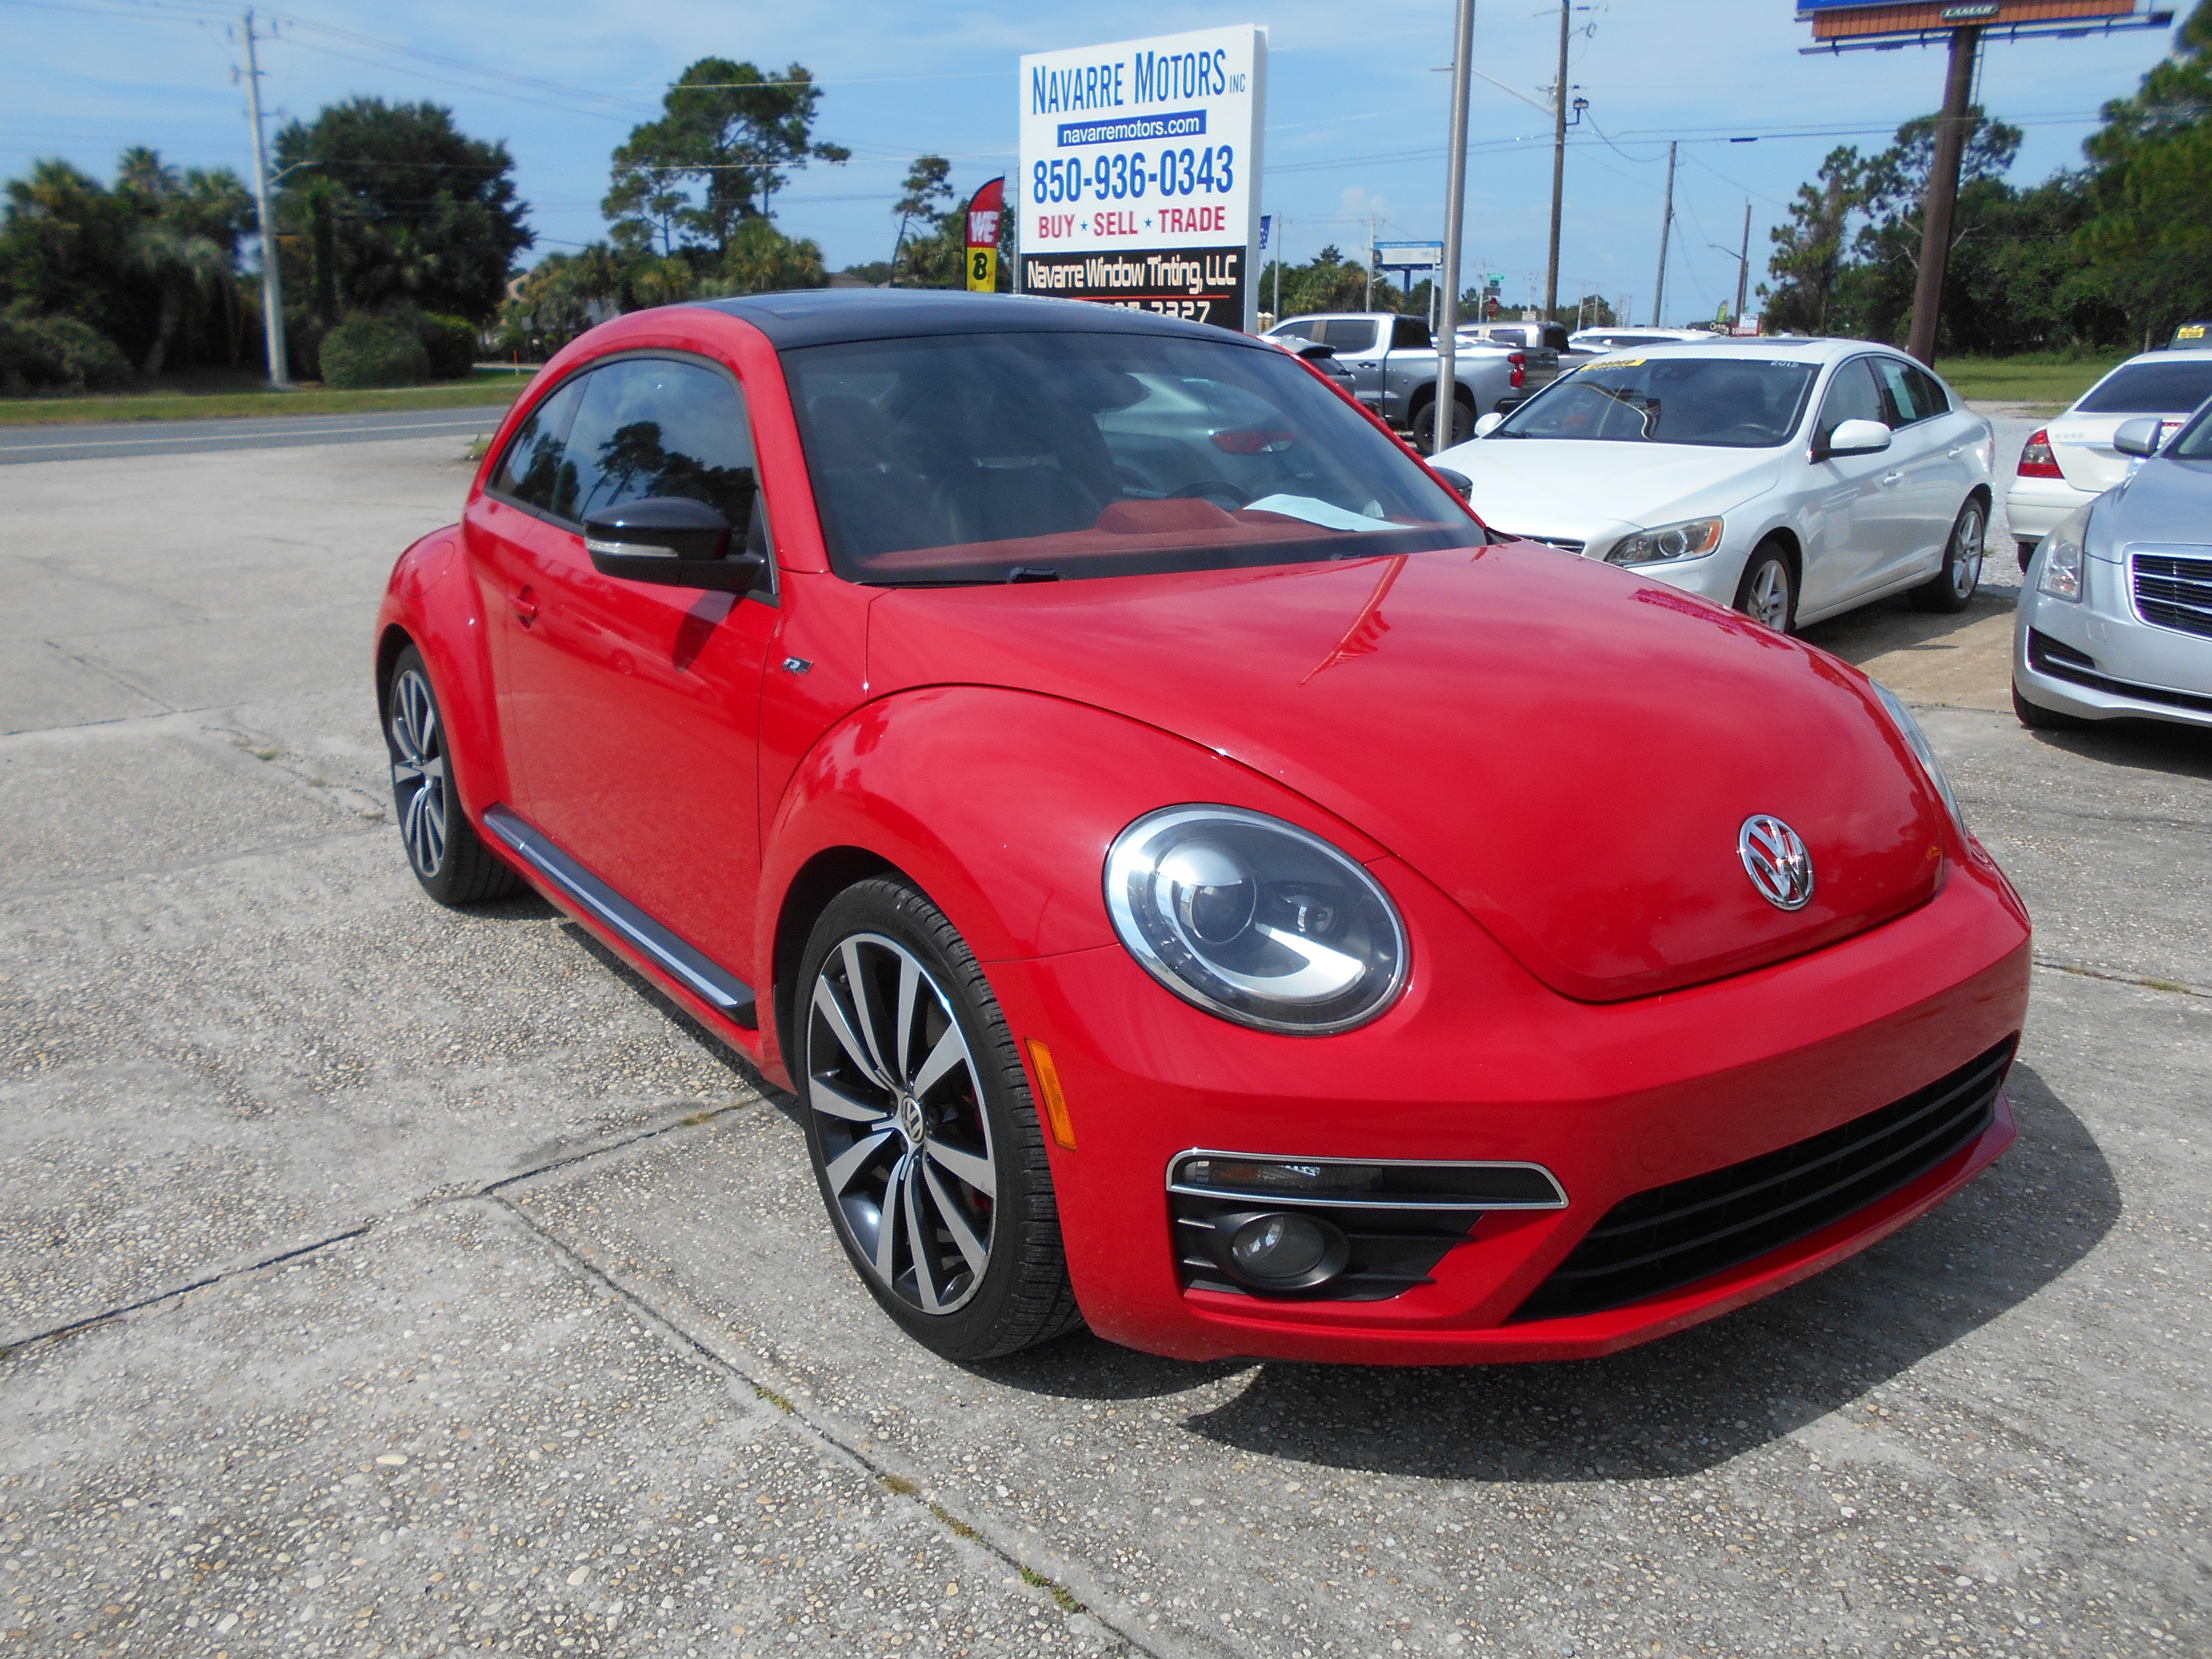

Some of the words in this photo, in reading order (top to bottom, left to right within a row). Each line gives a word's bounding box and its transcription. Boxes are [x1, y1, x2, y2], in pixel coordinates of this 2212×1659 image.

[1945, 6, 1993, 17] LAMAR
[1033, 62, 1124, 115] NAVARRE
[1135, 47, 1226, 104] MOTORS
[1230, 73, 1245, 93] INC
[1063, 117, 1199, 143] navarremotors.com
[1033, 144, 1234, 204] 850-936-0343
[970, 210, 999, 242] WE
[1039, 214, 1075, 238] BUY
[1094, 211, 1138, 236] SELL
[1158, 206, 1225, 233] TRADE
[1028, 260, 1084, 288] Navarre
[1086, 256, 1146, 287] Window
[1147, 255, 1203, 295] Tinting,
[1206, 255, 1237, 286] LLC
